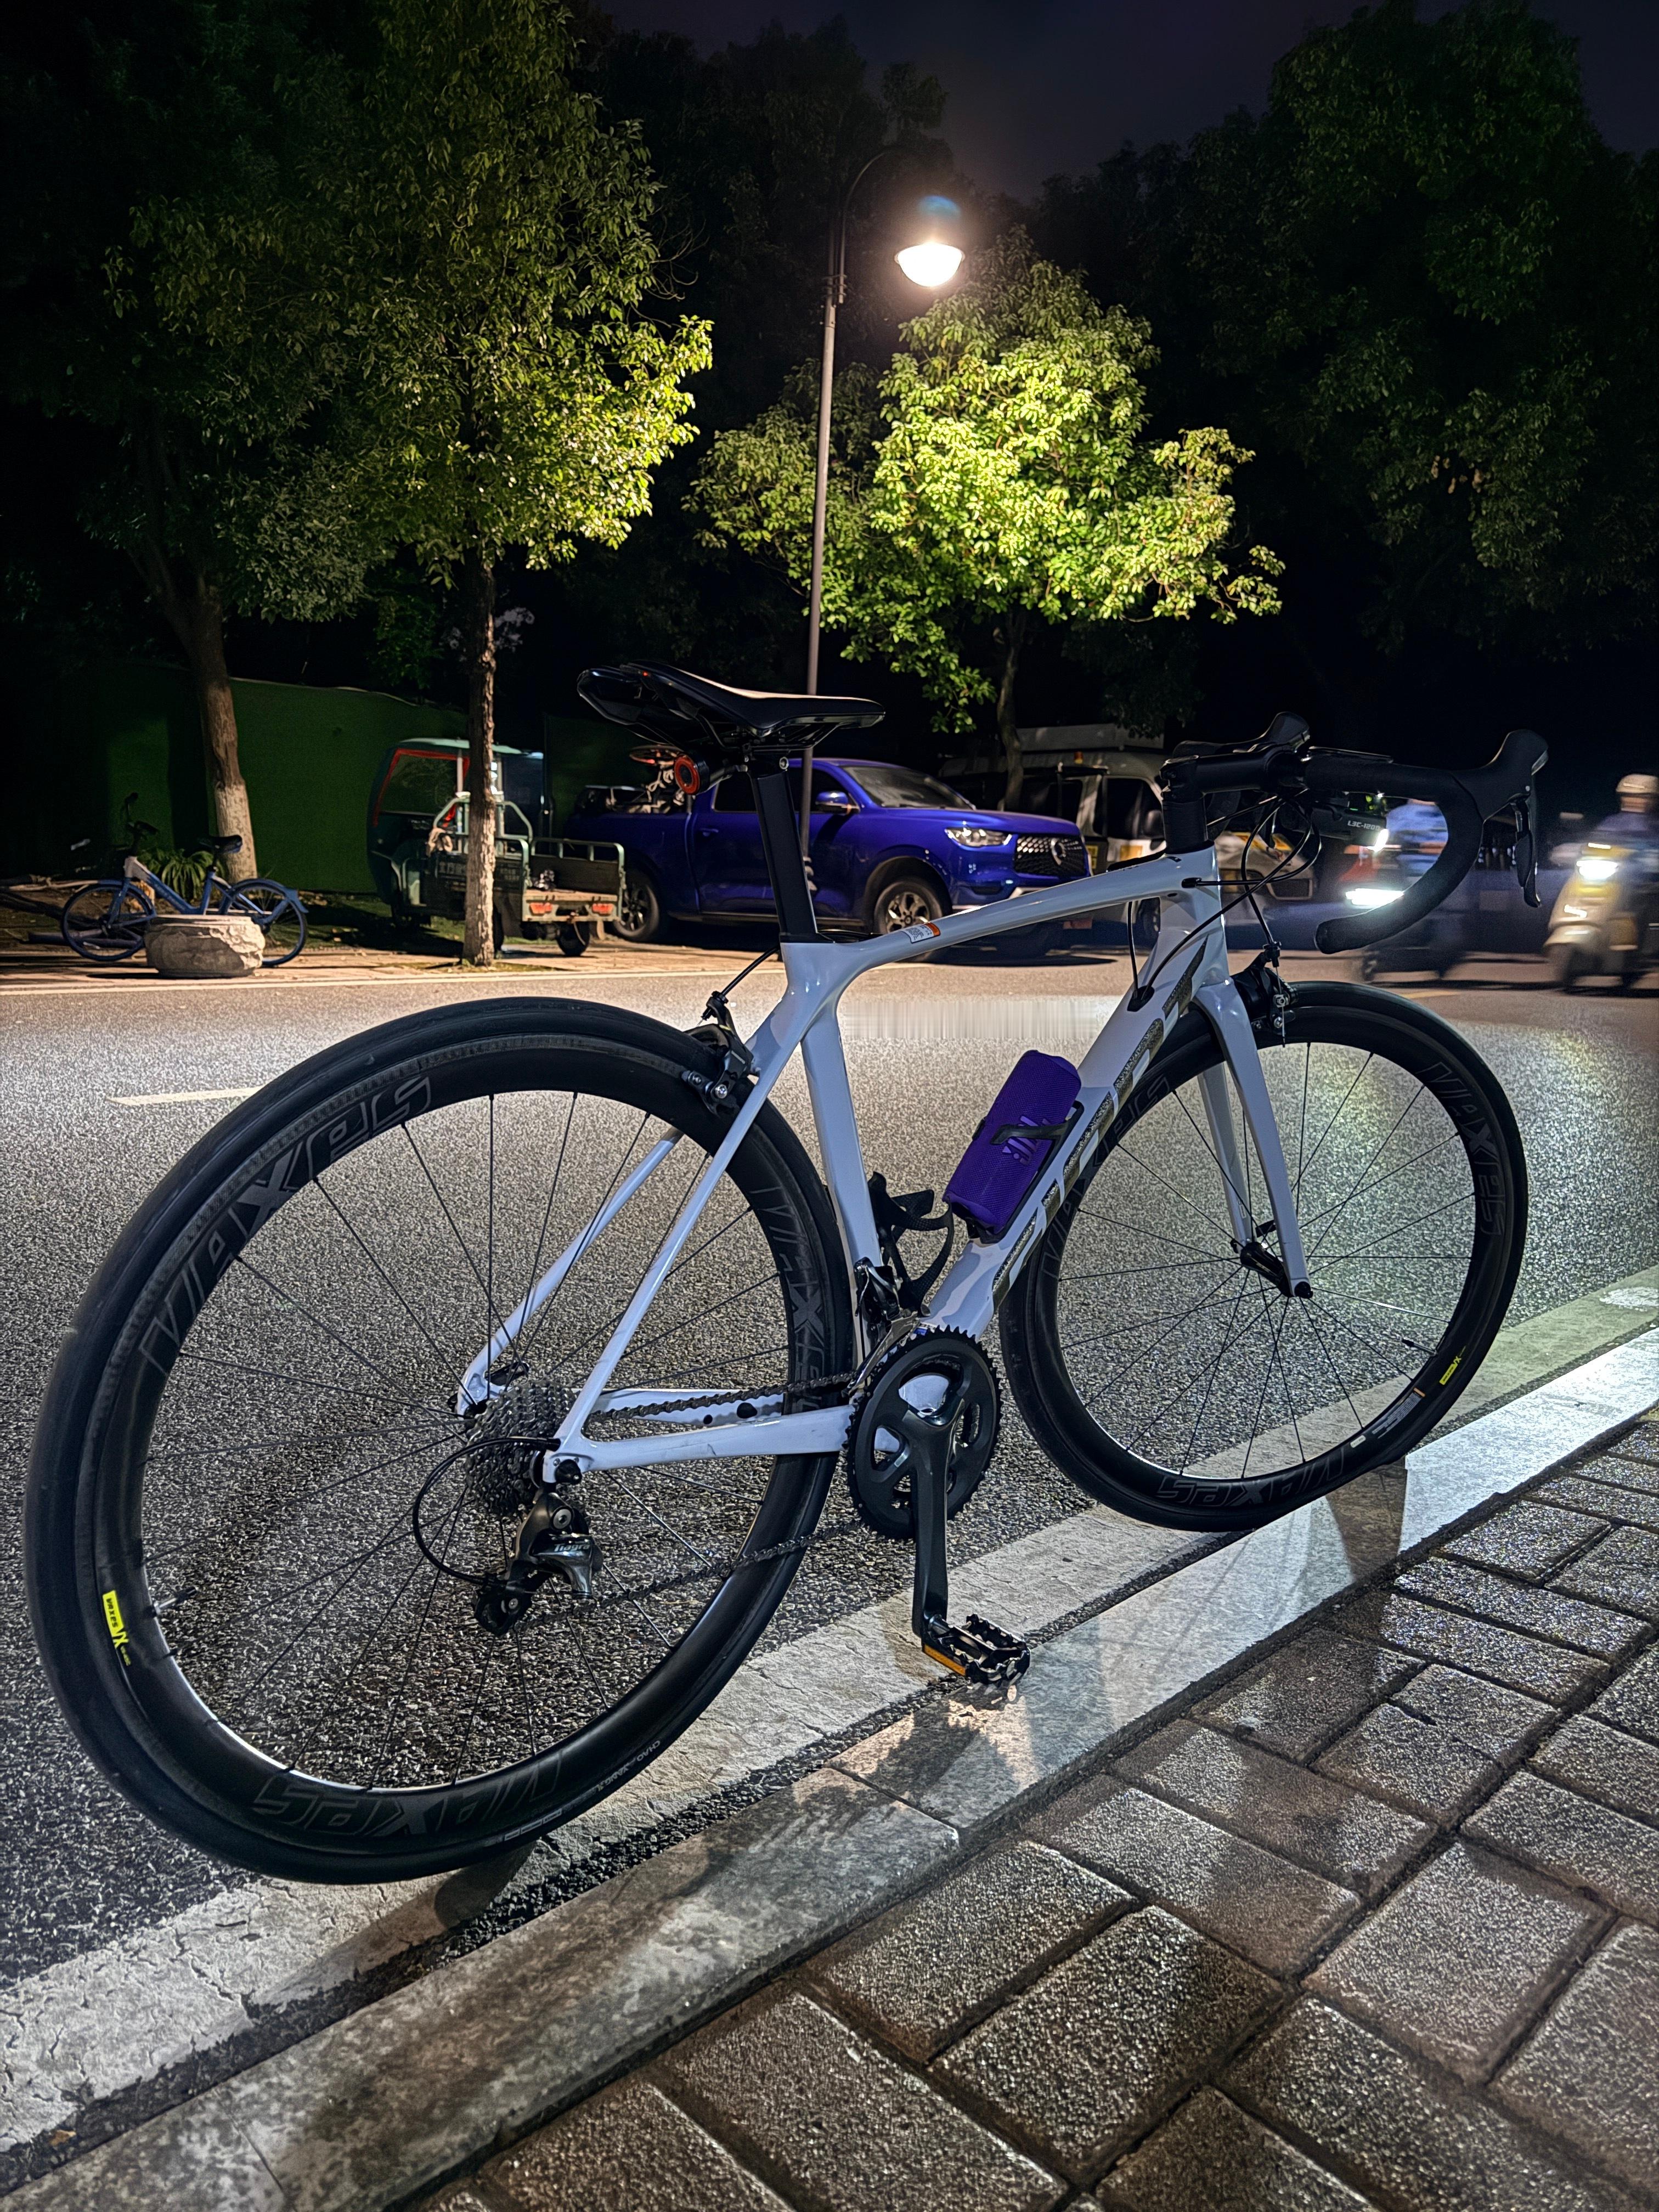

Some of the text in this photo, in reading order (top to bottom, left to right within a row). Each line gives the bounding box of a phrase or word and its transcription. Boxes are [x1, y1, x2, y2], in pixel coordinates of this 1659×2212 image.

[554, 1543, 590, 1552] Tiagra
[605, 1740, 661, 1785] CHAO YANG
